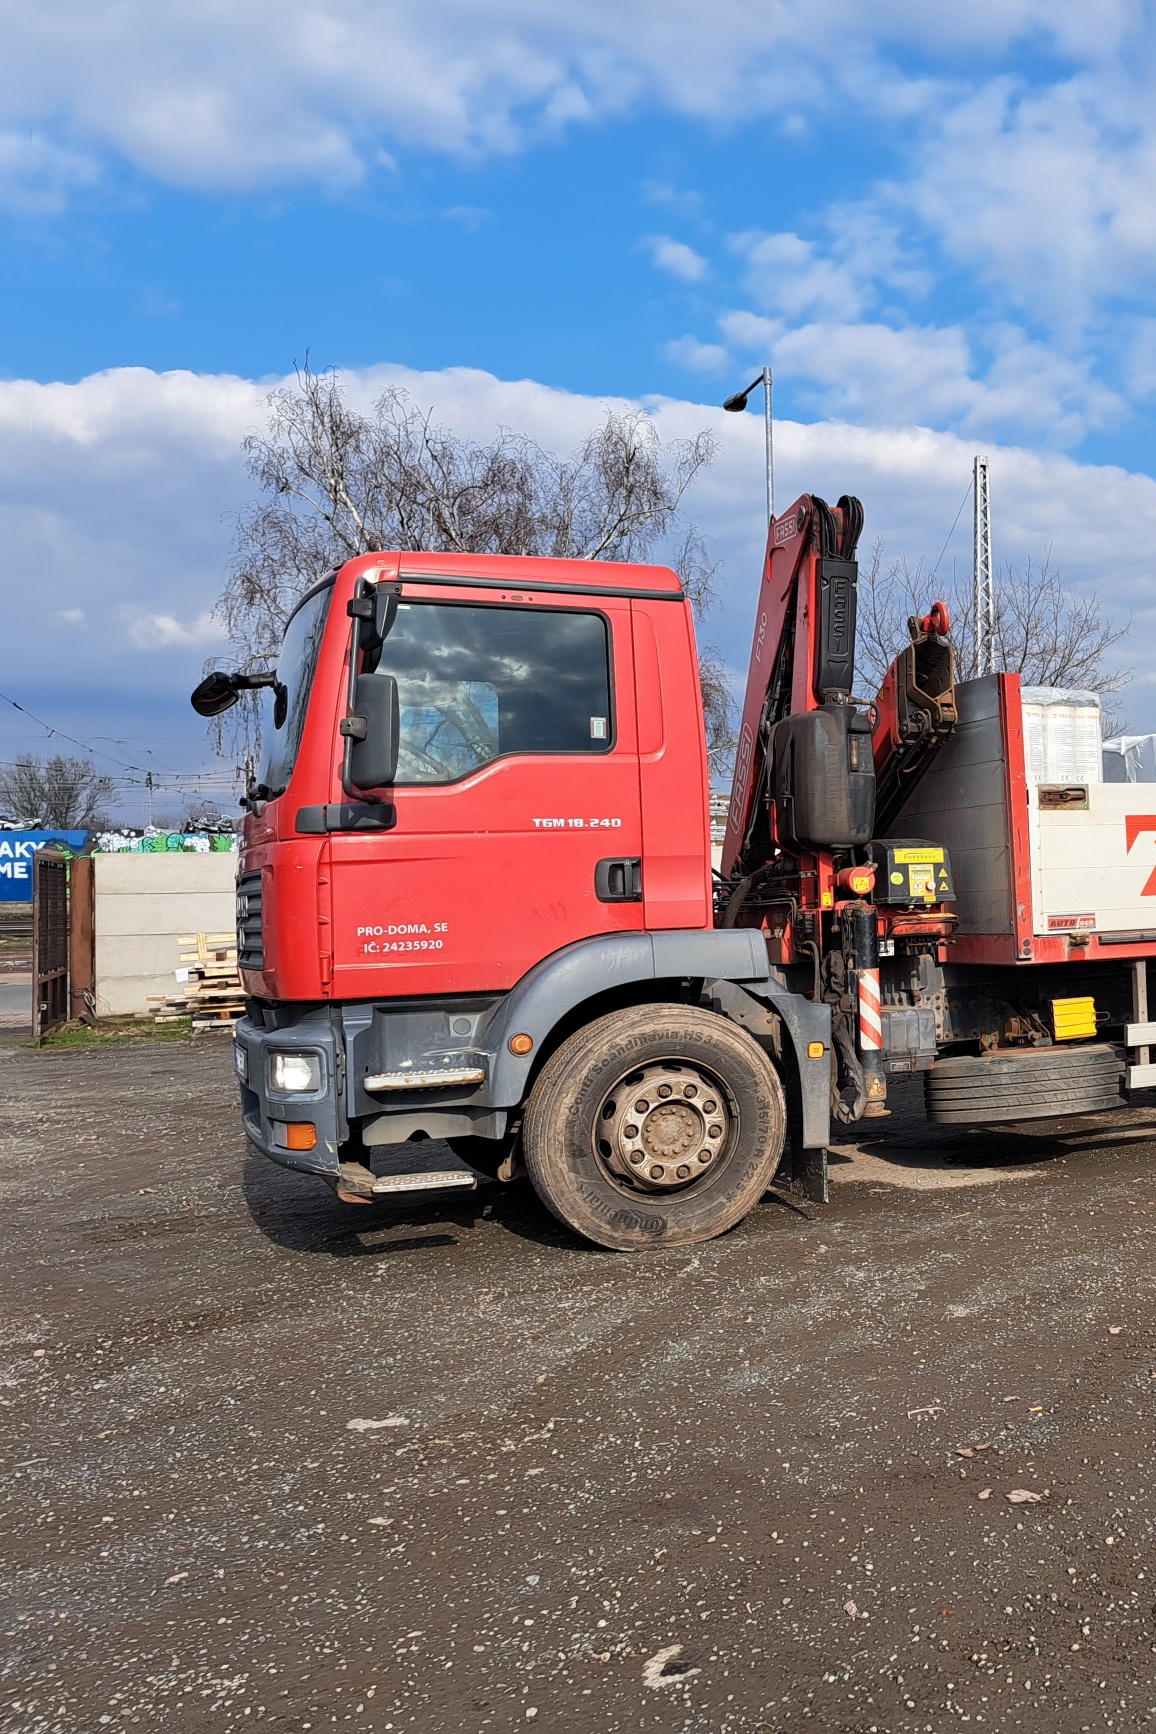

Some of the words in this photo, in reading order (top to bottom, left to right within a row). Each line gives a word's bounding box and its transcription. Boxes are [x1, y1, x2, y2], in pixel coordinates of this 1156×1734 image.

[775, 519, 795, 541] FASSI
[832, 579, 846, 651] FASSI
[755, 612, 768, 662] F130
[731, 729, 753, 827] FASSI
[531, 818, 565, 828] TGM
[567, 818, 622, 828] 18.240
[356, 923, 432, 937] PRO-DOMA,
[433, 922, 449, 933] SE
[1050, 919, 1076, 927] AUTO
[363, 941, 380, 953] IČ:
[382, 939, 443, 952] 24235920
